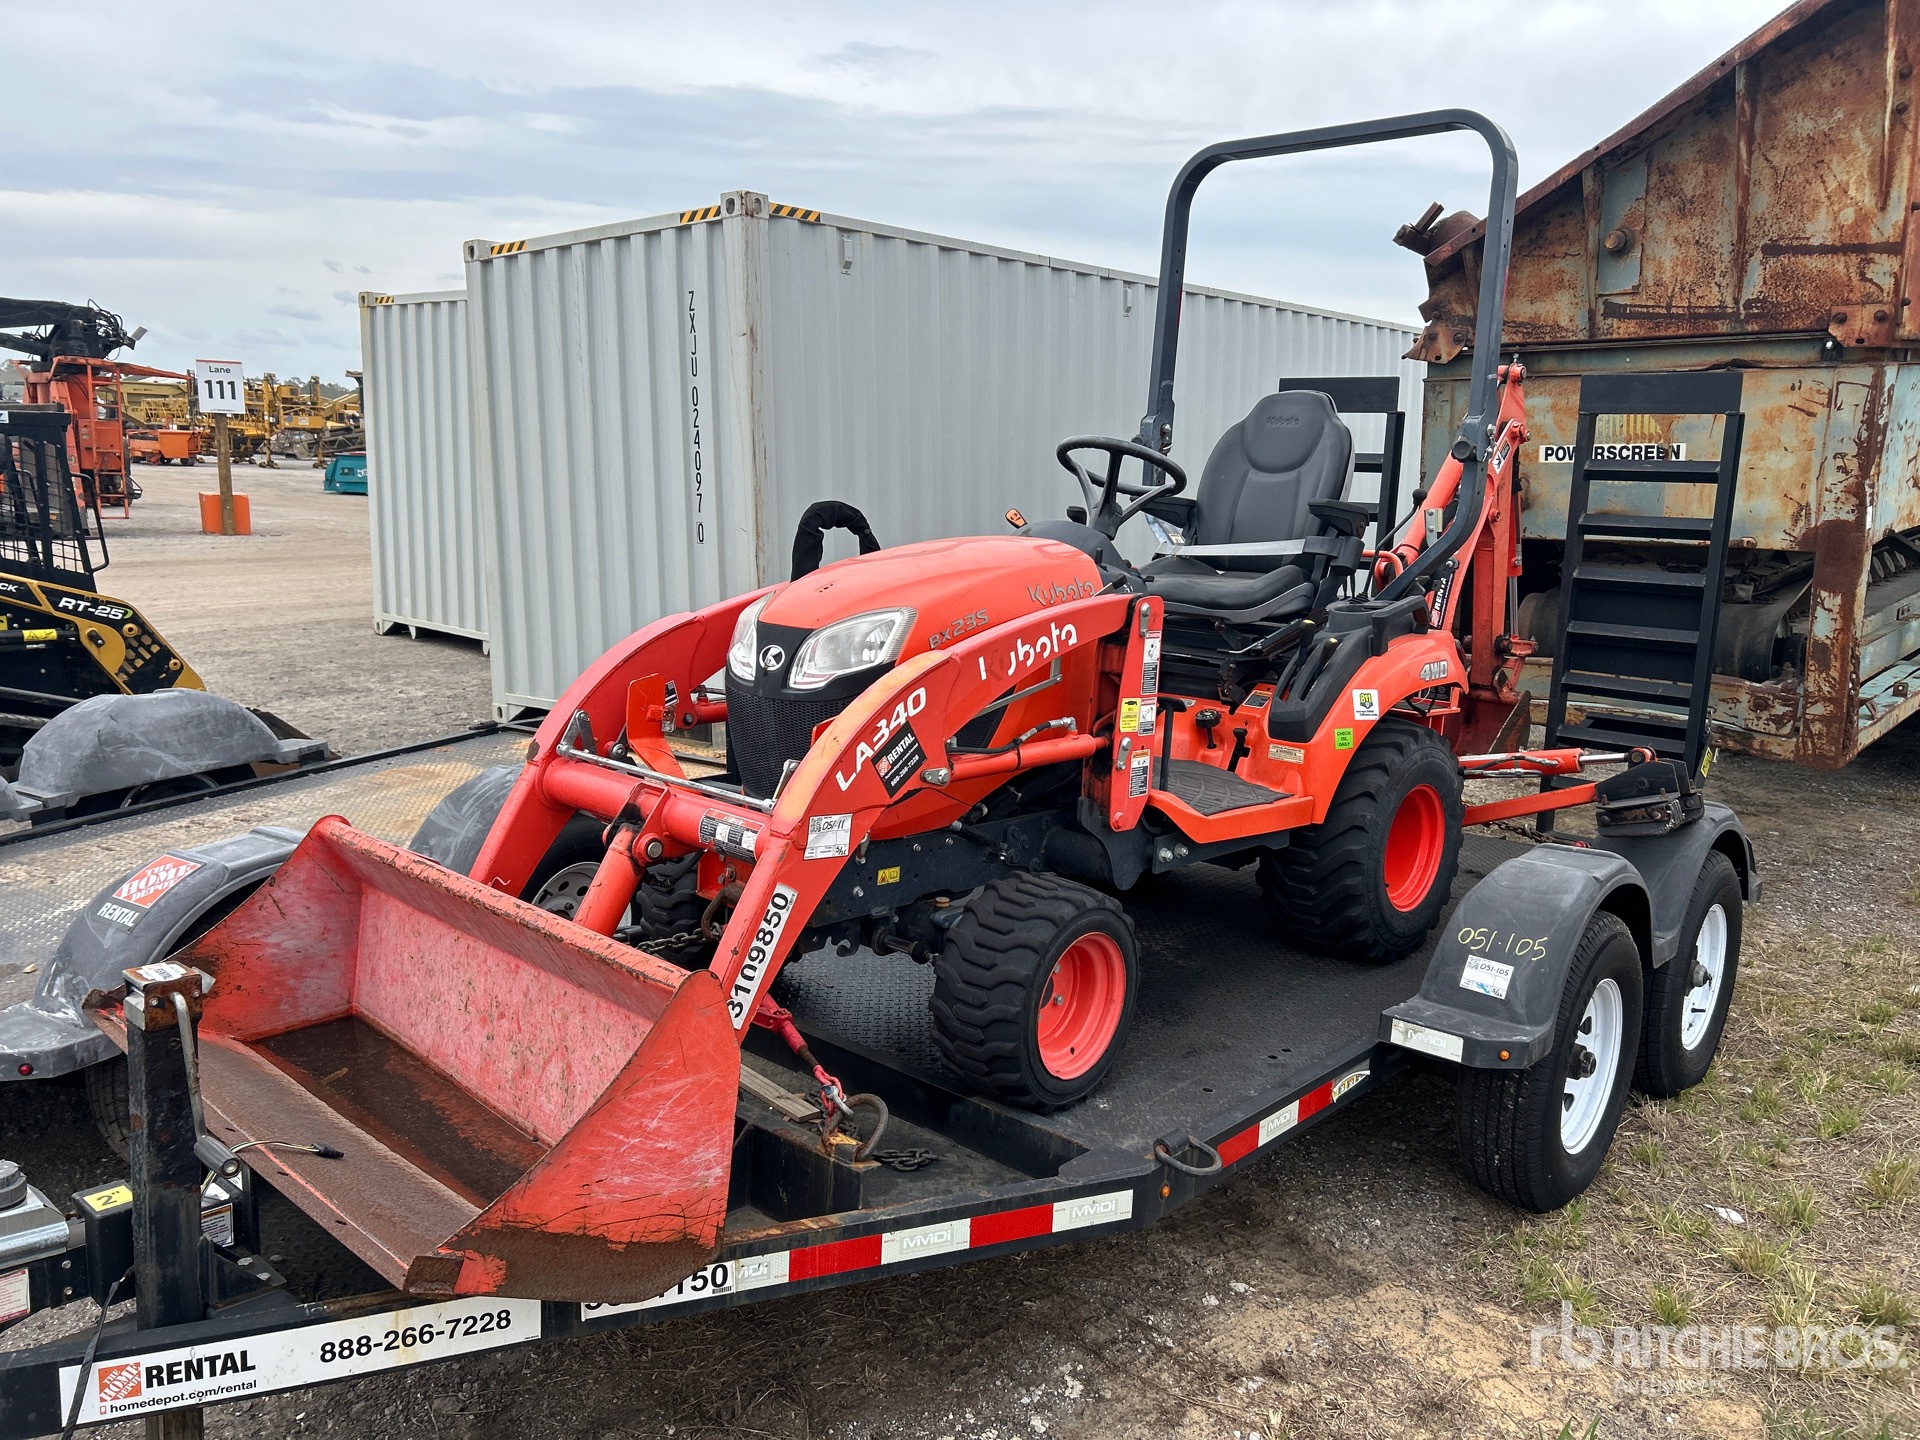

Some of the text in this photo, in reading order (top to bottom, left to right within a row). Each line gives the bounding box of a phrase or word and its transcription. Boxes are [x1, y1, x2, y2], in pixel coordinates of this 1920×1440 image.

[209, 365, 231, 374] Lane
[204, 379, 237, 400] 111
[688, 290, 705, 544] ZXJU 024097 0
[1544, 444, 1681, 462] POWRSCREEN
[1027, 577, 1096, 606] Kubota
[58, 596, 125, 620] RT-25
[928, 608, 990, 650] BX23S
[1419, 660, 1449, 682] 4WD
[1359, 693, 1372, 703] 811
[835, 687, 927, 792] LA340
[886, 732, 916, 764] RENTAL
[120, 864, 192, 897] HOME
[145, 863, 175, 876] THE
[131, 879, 178, 902] DEPOT
[97, 902, 139, 927] RENTAL
[726, 891, 790, 1019] 3109850
[319, 1309, 512, 1363] 888-266-7228
[99, 1363, 142, 1402] HOME
[102, 1369, 121, 1385] THE
[145, 1350, 256, 1389] RENTAL
[110, 1379, 257, 1413] homedepot.com/rental
[116, 1377, 142, 1400] DEPOT
